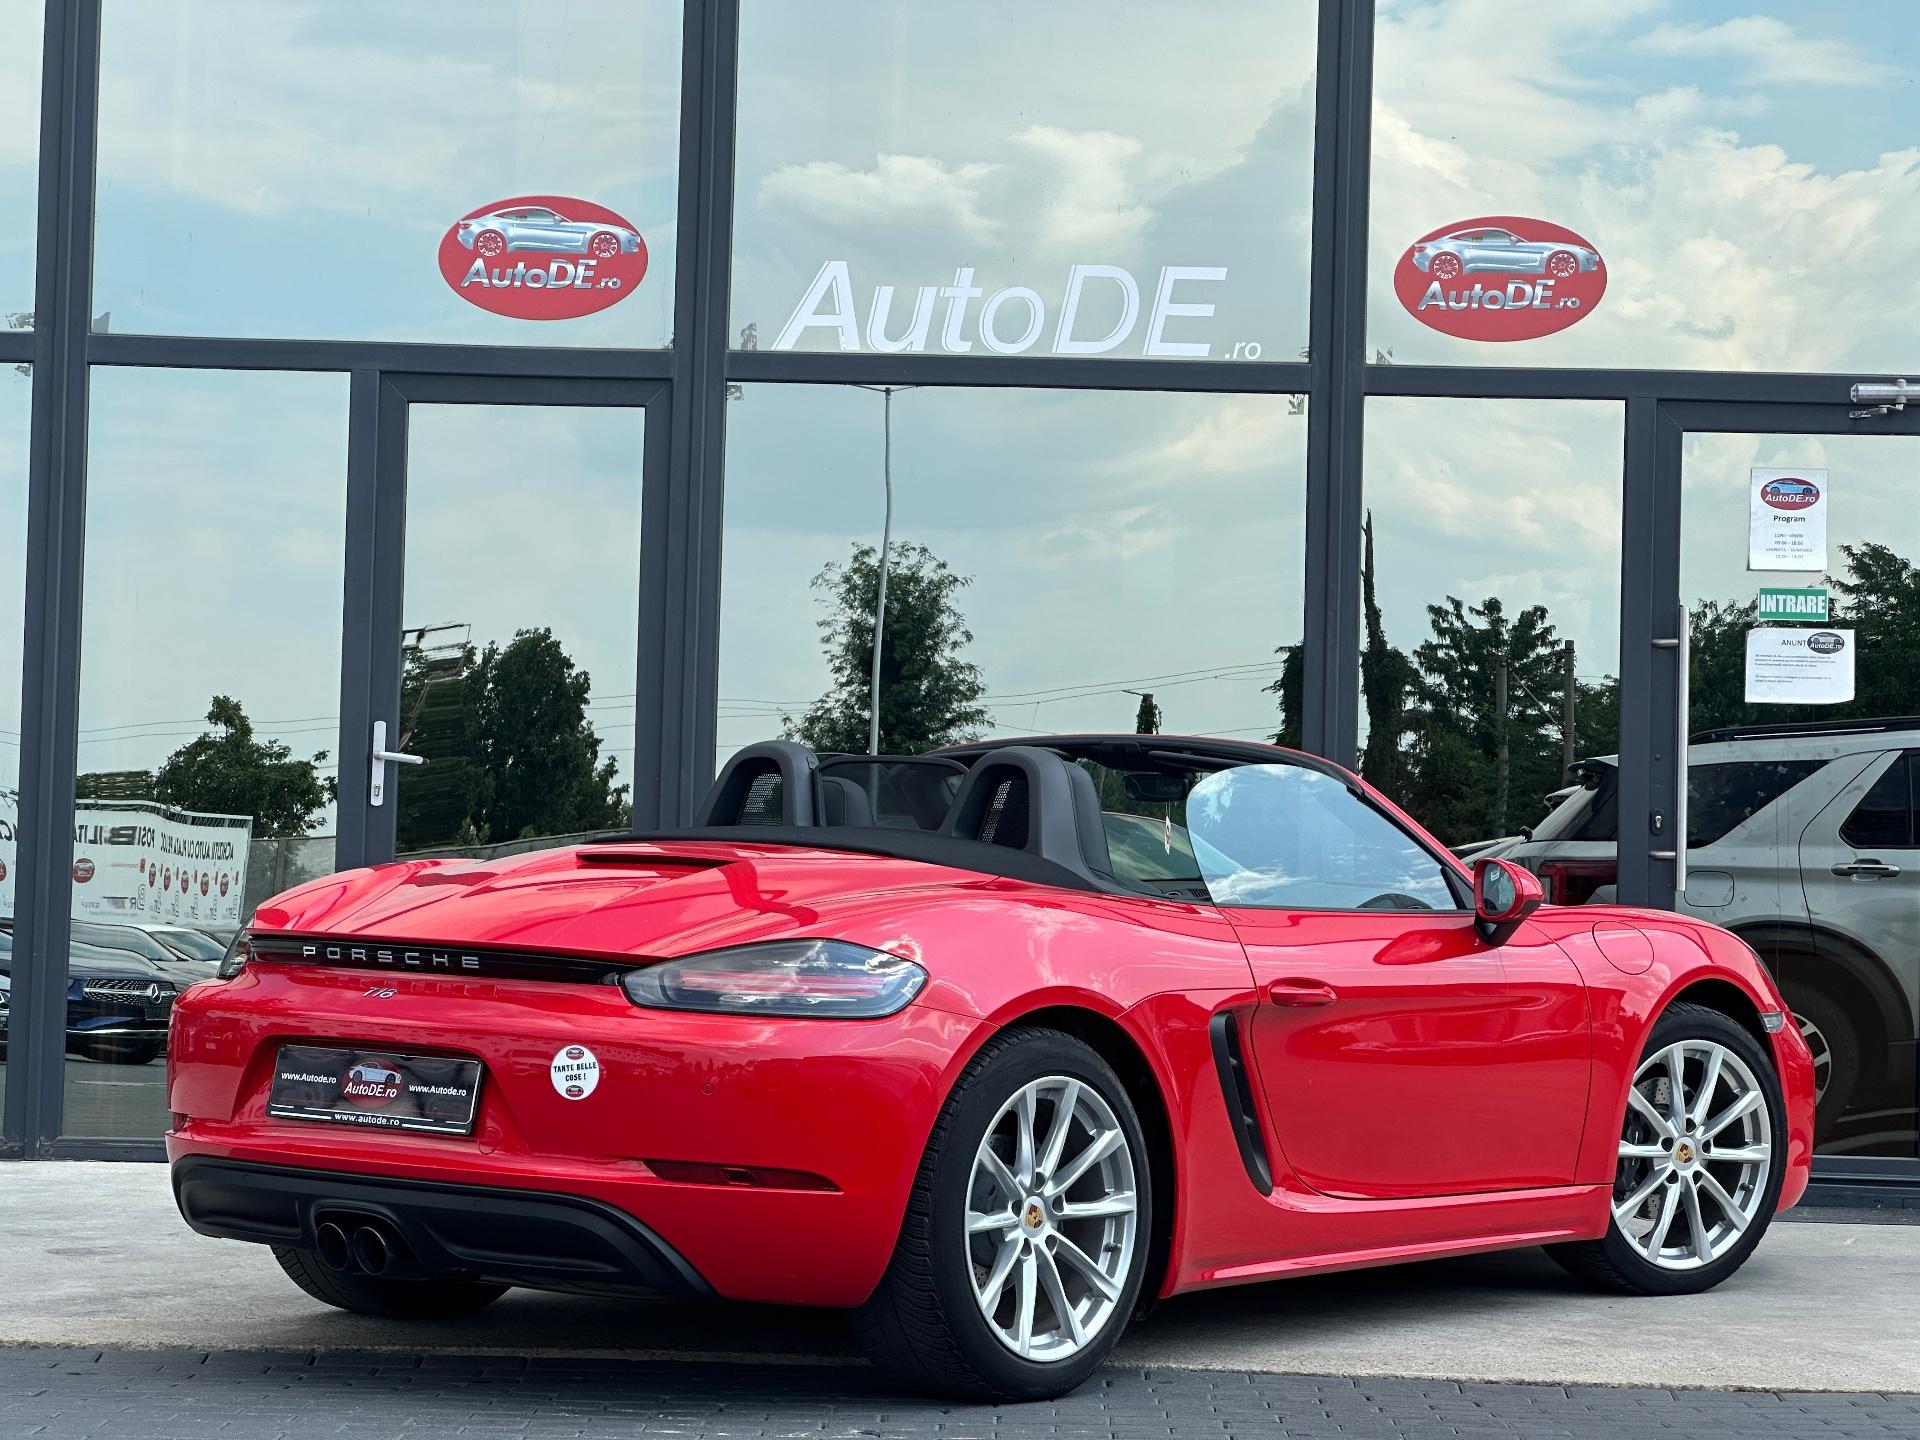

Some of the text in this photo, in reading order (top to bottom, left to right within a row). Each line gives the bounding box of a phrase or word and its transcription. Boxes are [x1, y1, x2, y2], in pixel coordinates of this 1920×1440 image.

[1765, 493, 1815, 503] AutoDE.ro
[1773, 514, 1806, 523] Program
[1760, 594, 1826, 614] INTRARE
[302, 945, 480, 969] PORSCHE
[362, 986, 398, 999] 718
[553, 1061, 597, 1073] TANTE BELLE
[281, 1071, 337, 1084] www.Autode.ro
[344, 1082, 397, 1098] AutoDE.ro
[409, 1084, 467, 1097] www.Autode.ro
[334, 1112, 400, 1126] www.autode.ro
